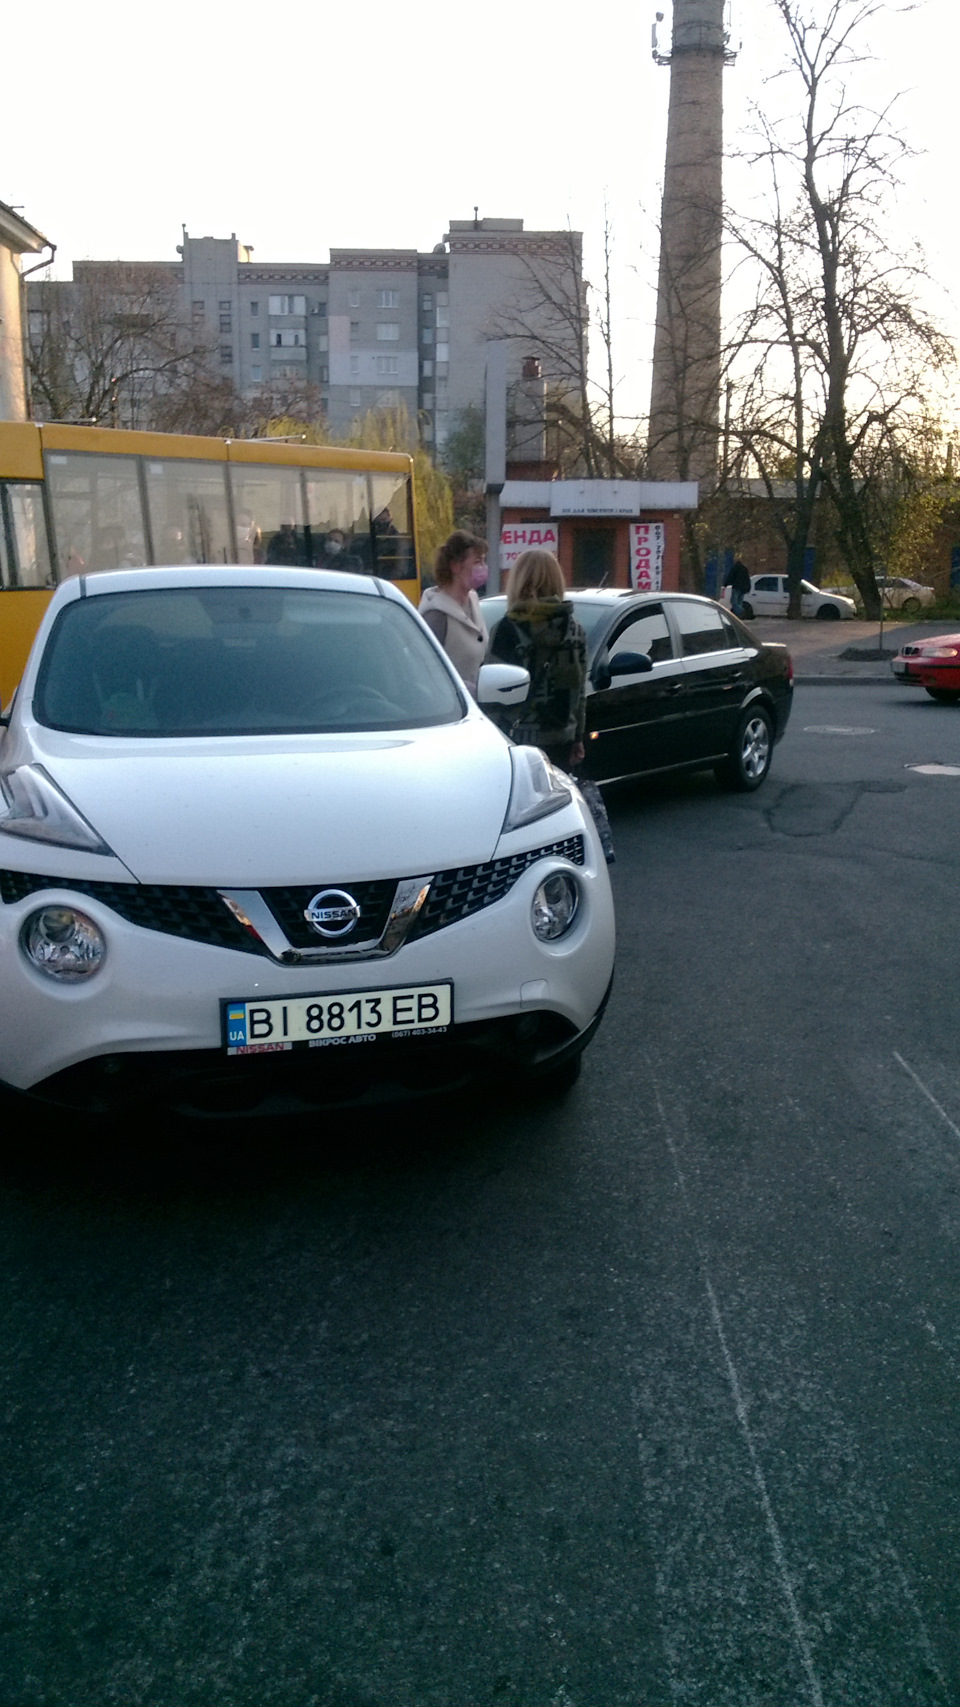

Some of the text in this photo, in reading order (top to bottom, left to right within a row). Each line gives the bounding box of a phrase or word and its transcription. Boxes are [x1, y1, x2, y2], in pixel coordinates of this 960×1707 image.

[501, 529, 556, 545] ЕНДА
[635, 525, 651, 590] ПРОДАМ
[311, 909, 356, 919] NISSAN
[306, 998, 382, 1034] 8813
[229, 1030, 245, 1041] UA
[237, 1043, 284, 1055] NISSAN
